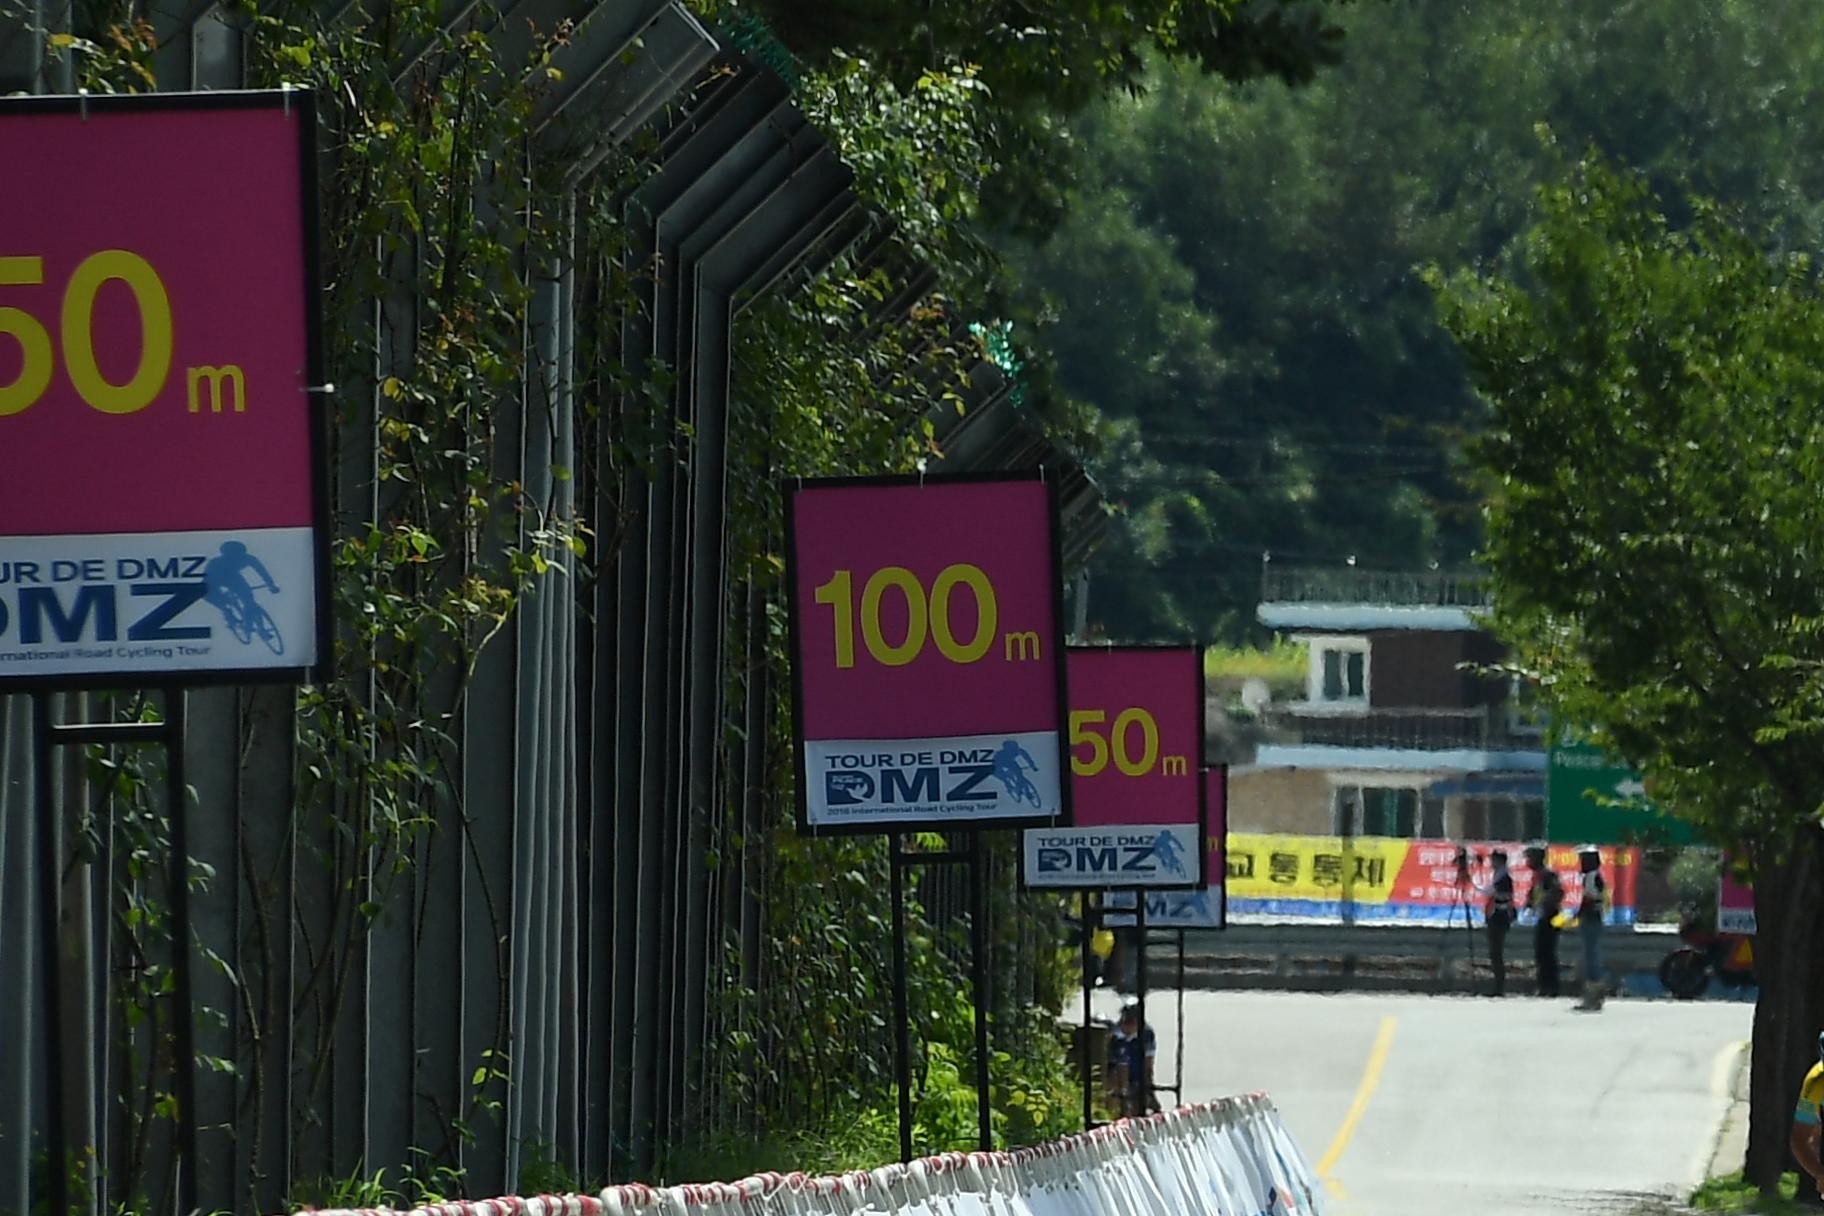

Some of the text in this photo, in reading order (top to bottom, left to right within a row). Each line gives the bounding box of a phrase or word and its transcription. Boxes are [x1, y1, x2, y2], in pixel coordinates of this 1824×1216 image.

[187, 364, 246, 413] m
[52, 559, 106, 582] DE
[116, 556, 208, 580] DMZ
[0, 581, 212, 645] MZ
[814, 563, 1041, 668] 100 m
[0, 648, 70, 662] rnational
[116, 645, 173, 659] Cycling
[177, 644, 210, 656] Tour
[825, 749, 995, 769] TOUR DE DMZ
[1162, 755, 1187, 776] m
[825, 765, 998, 806] DMZ
[1037, 835, 1156, 848] TOUR DE DMZ
[1037, 847, 1157, 872] DMZ
